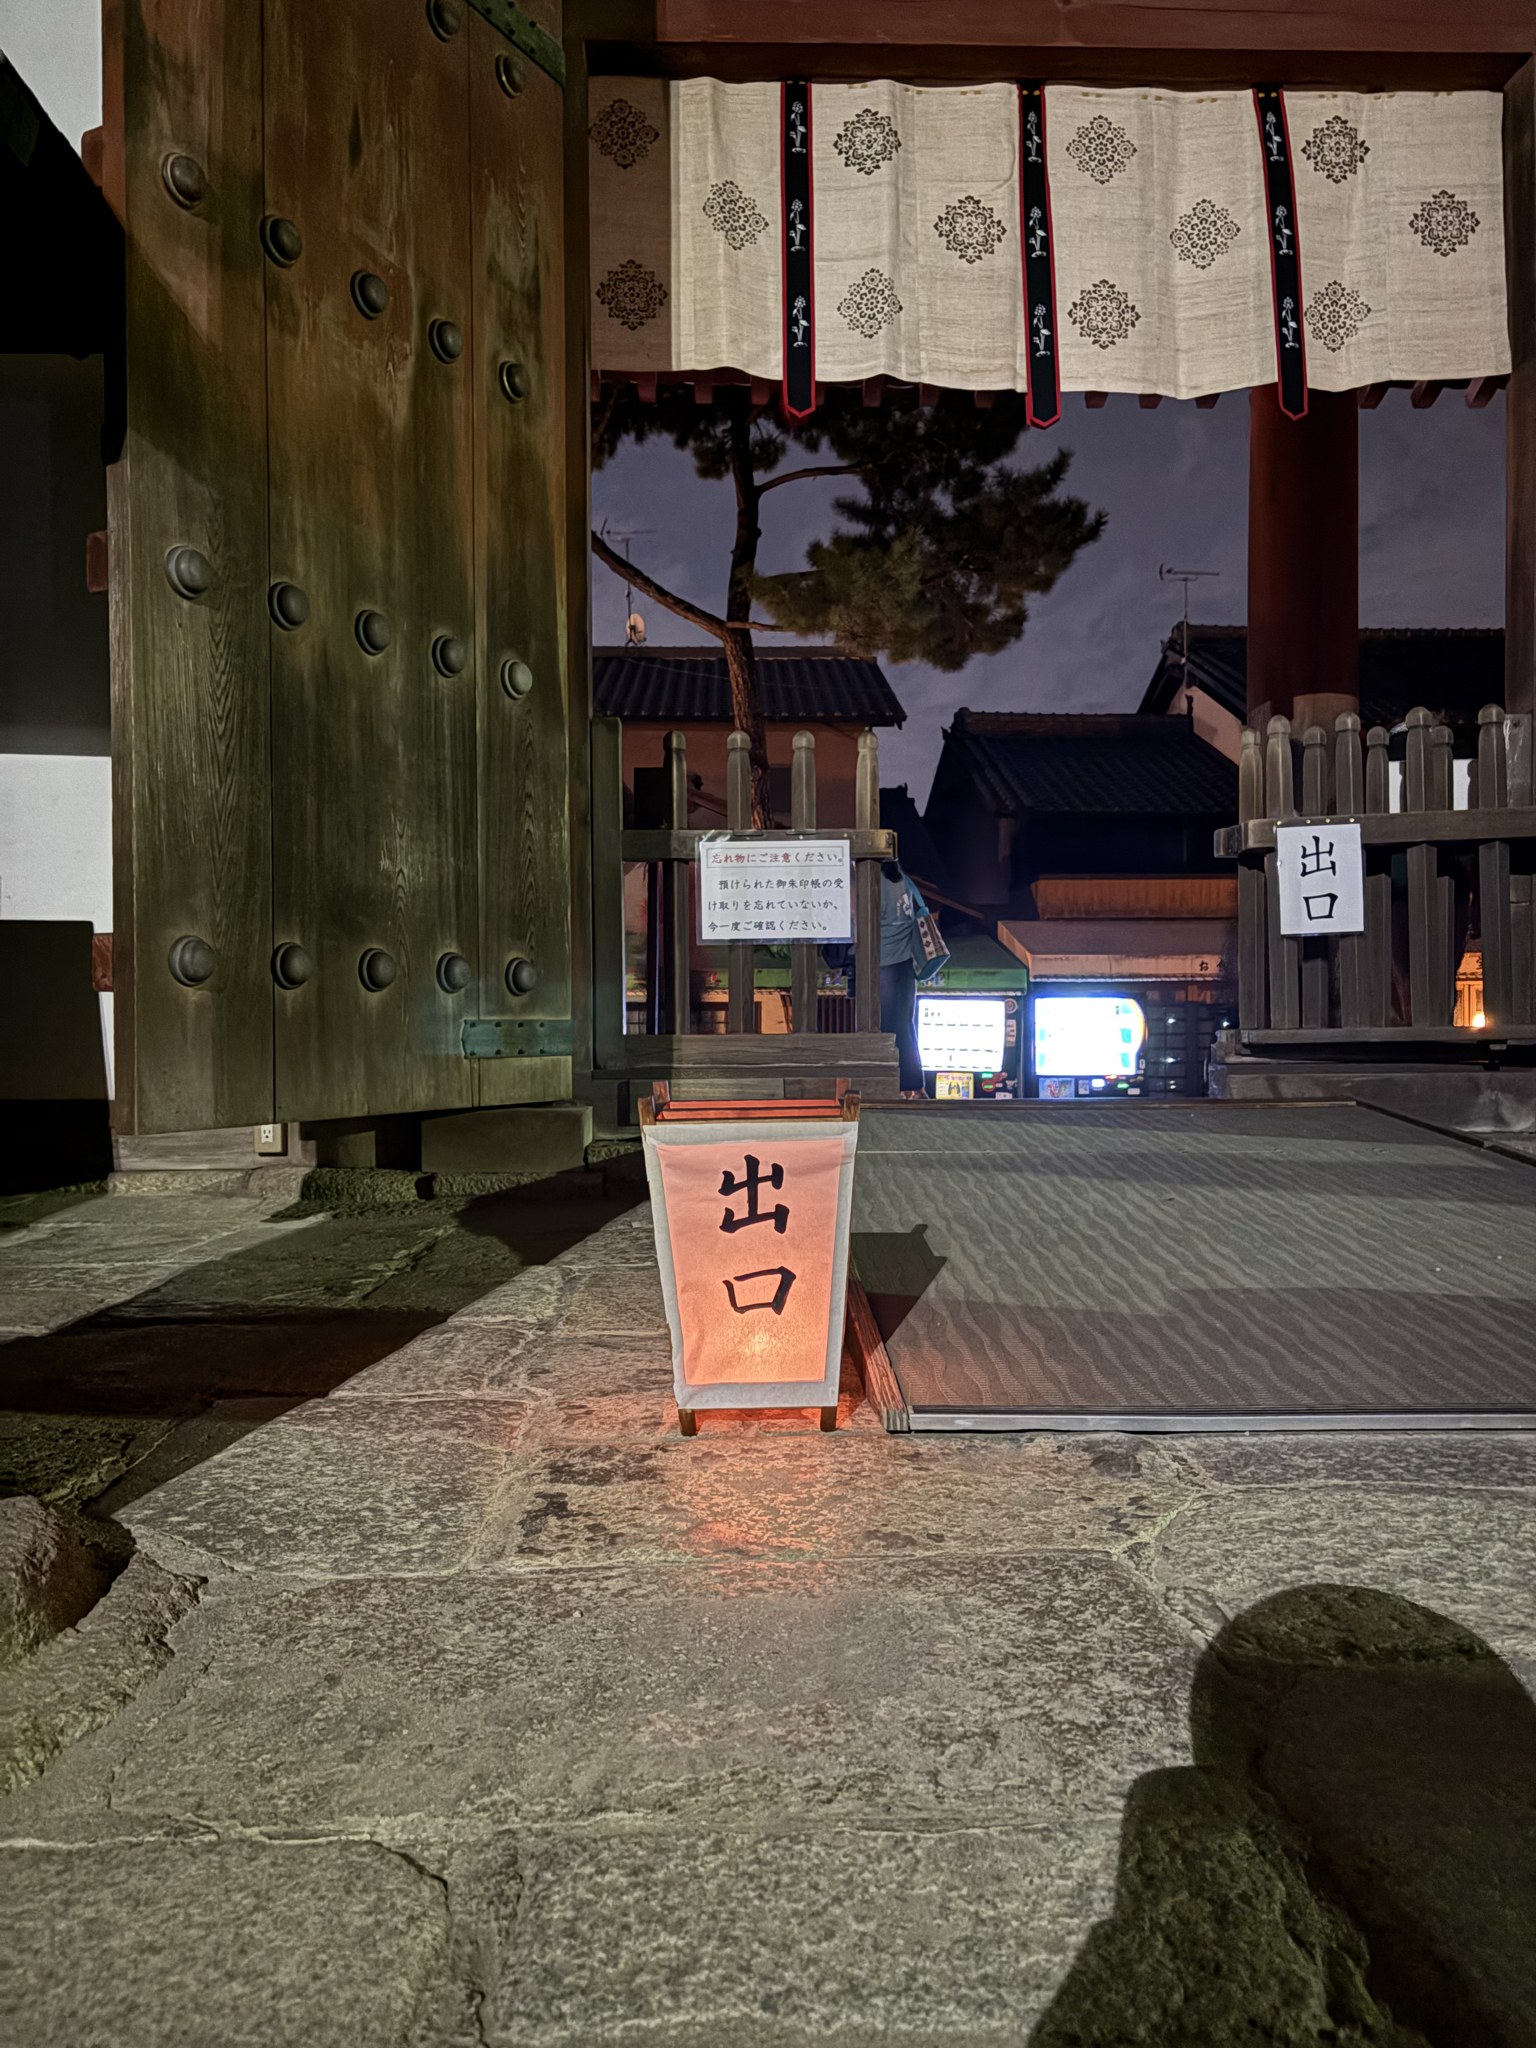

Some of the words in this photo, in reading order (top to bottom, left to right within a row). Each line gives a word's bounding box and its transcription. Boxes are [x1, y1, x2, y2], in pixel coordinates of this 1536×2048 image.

[711, 851, 843, 864] 忘れ物にご注意ください。
[718, 877, 844, 890] 預けられた御朱印帳の受
[1300, 835, 1338, 921] 出口
[707, 899, 839, 911] け取りを忘れていないか、
[707, 920, 828, 932] 今一度ご確認ください。
[718, 1154, 797, 1316] 出口
